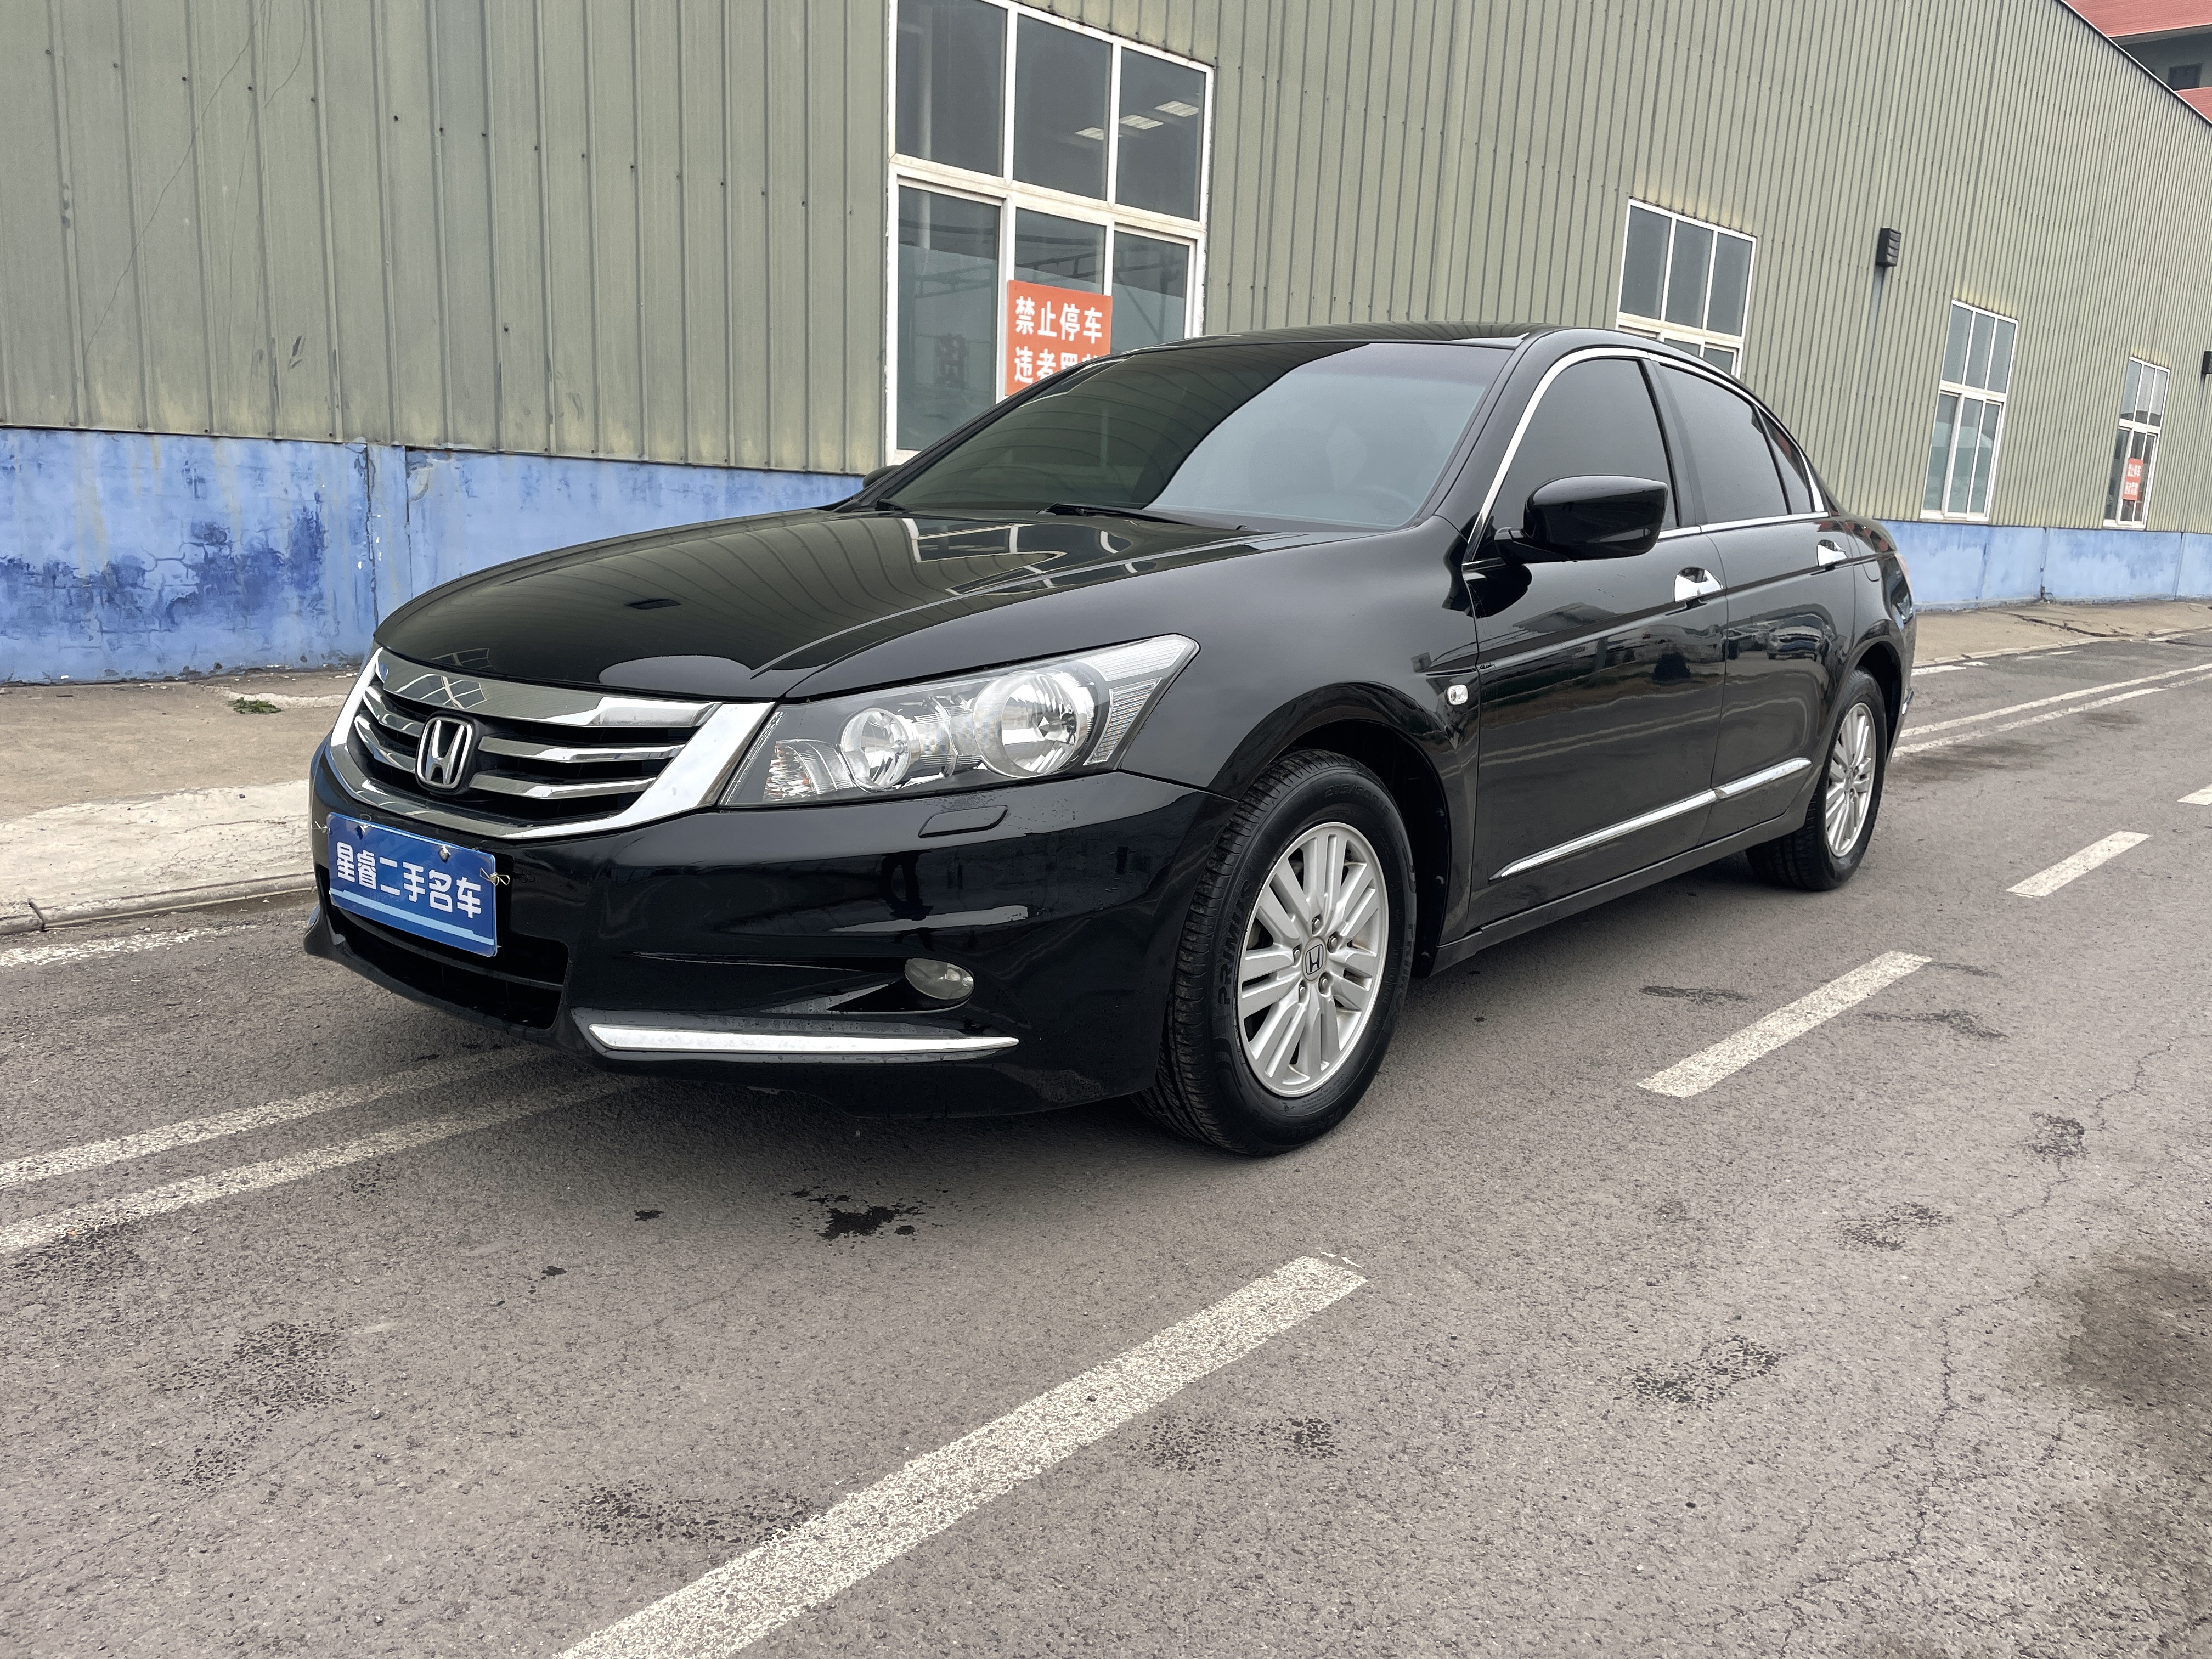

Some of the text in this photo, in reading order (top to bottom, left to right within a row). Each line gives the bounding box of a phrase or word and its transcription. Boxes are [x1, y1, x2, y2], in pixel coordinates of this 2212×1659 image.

[1015, 296, 1103, 344] 禁止停车
[336, 842, 482, 919] 星睿二手名车
